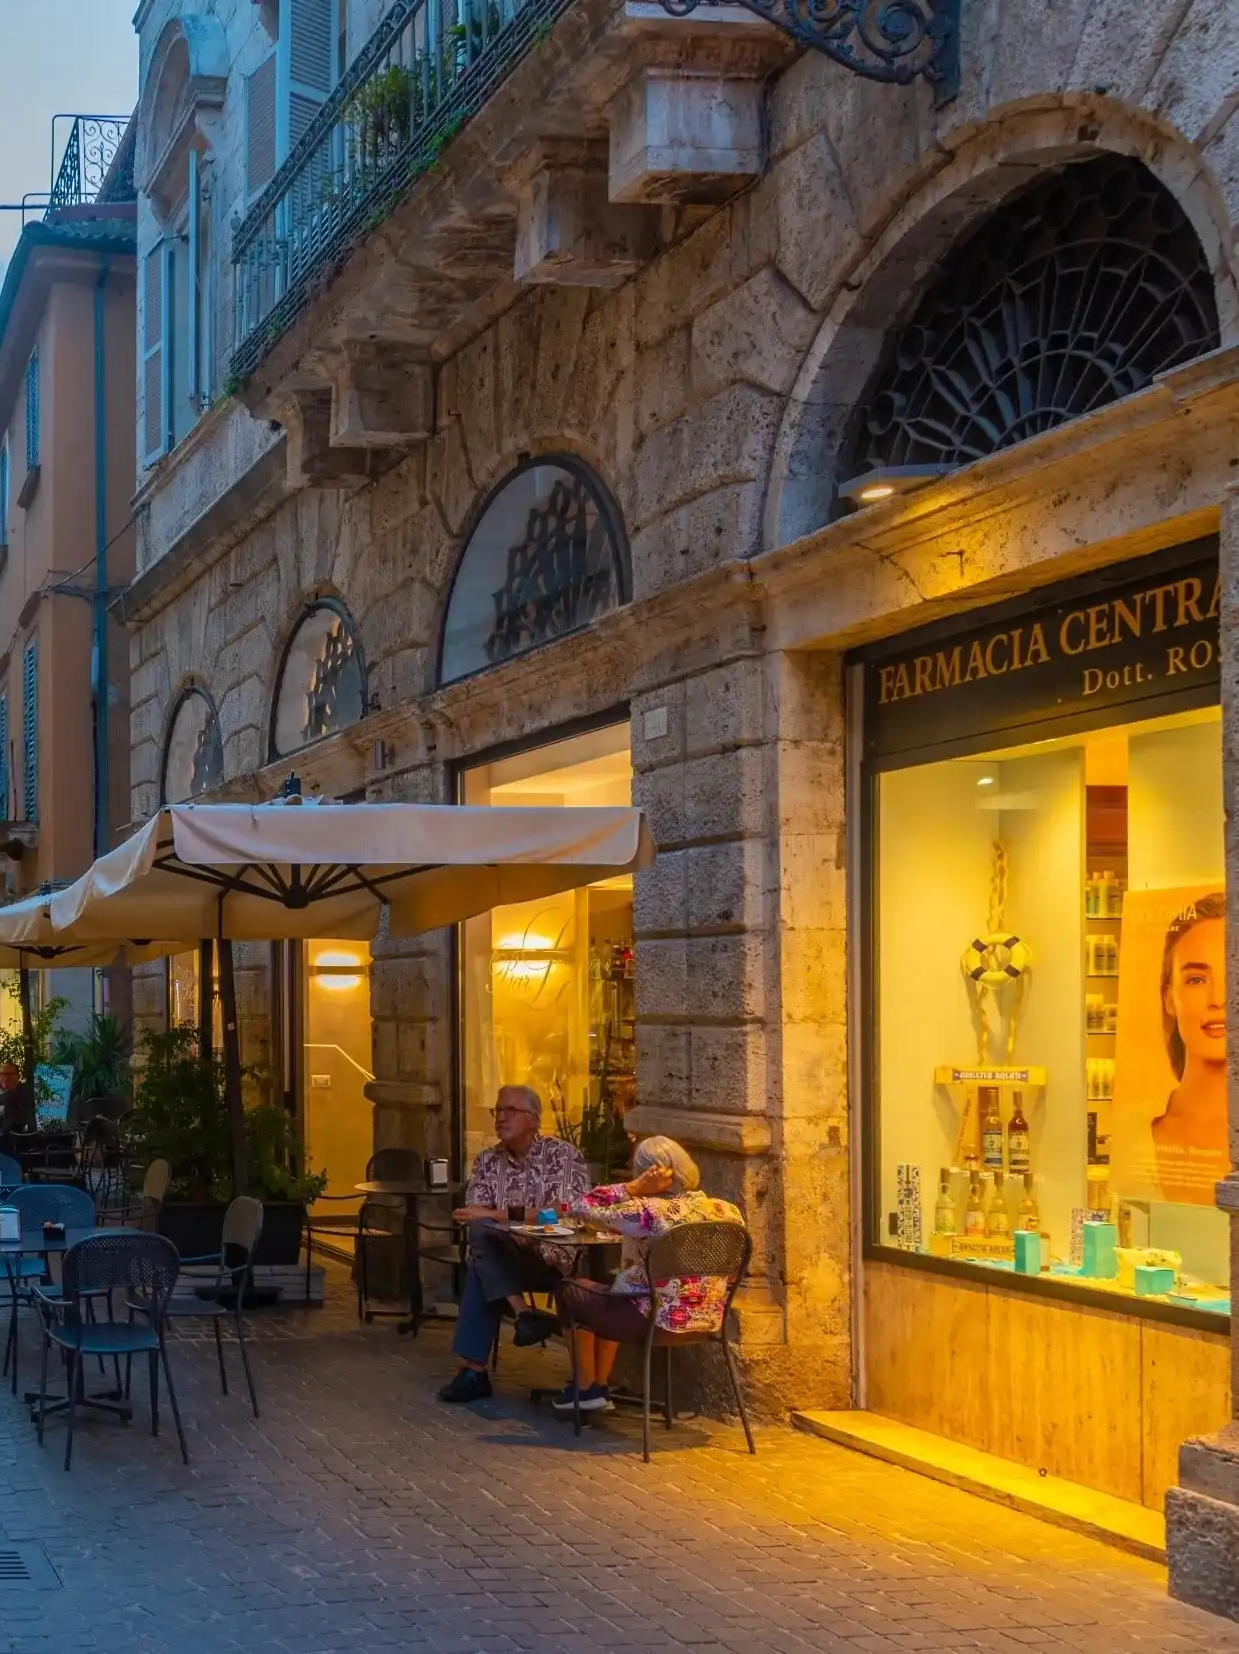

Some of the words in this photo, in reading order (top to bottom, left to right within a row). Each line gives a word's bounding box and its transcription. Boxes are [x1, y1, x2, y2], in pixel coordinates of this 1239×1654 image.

[878, 623, 1051, 705] FARMACIA
[1082, 661, 1153, 696] Dott.
[1166, 640, 1221, 676] RO
